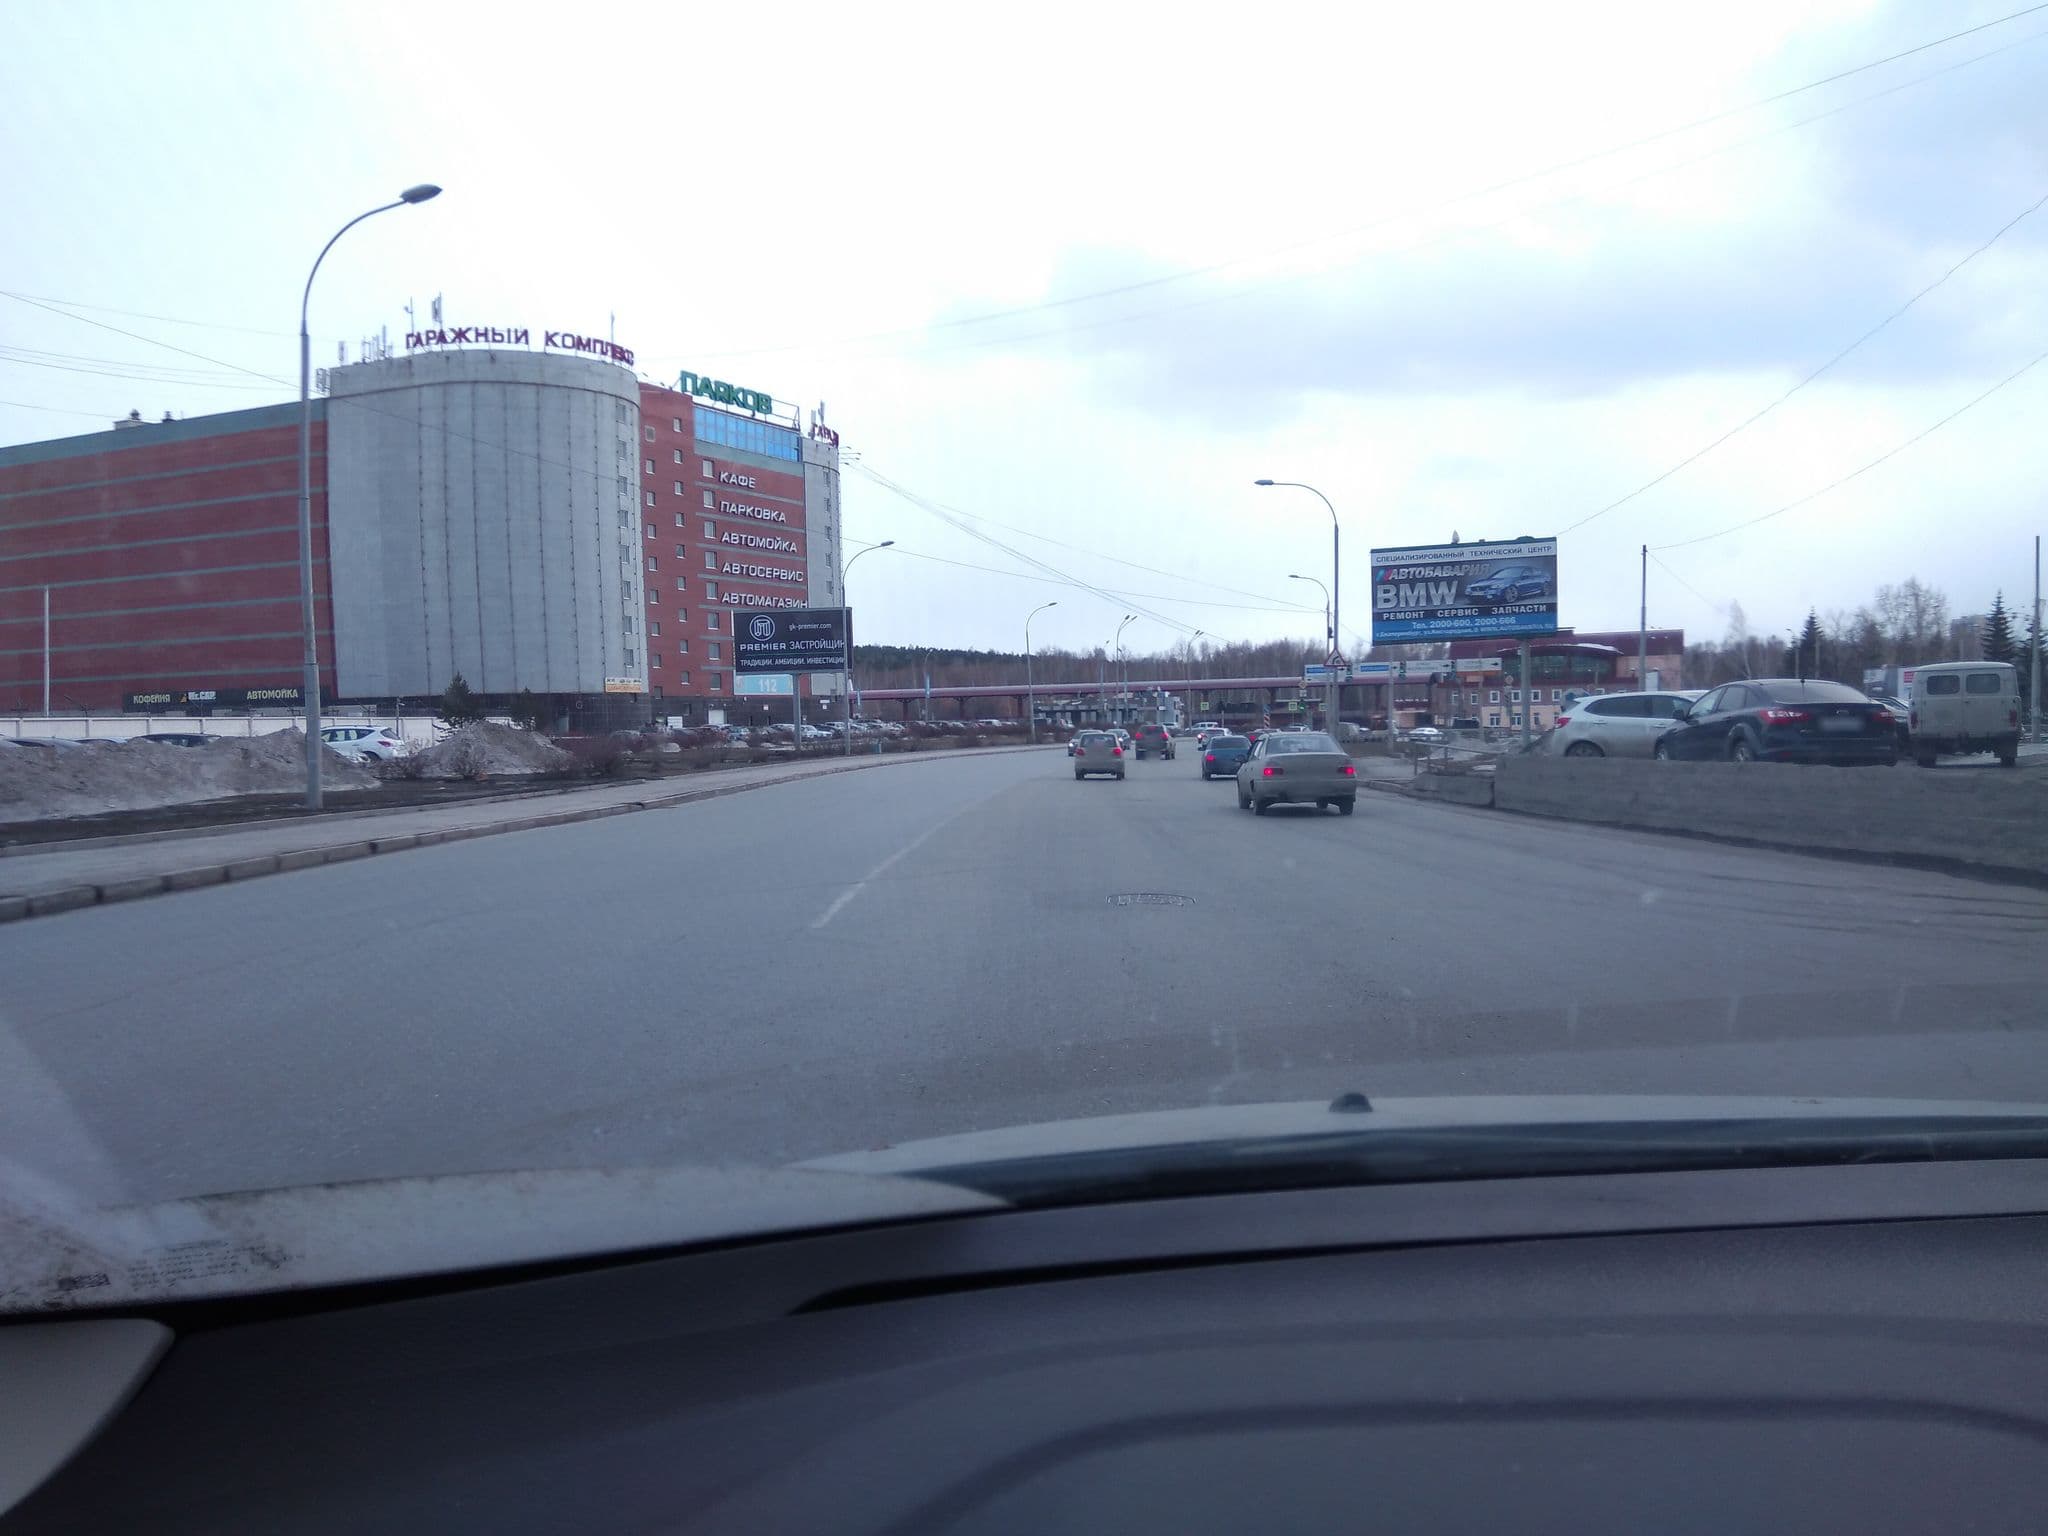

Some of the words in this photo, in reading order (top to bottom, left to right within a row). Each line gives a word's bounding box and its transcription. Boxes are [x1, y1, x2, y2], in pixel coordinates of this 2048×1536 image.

[680, 370, 773, 414] ПАРКОВ
[719, 471, 756, 489] КАФЕ
[719, 501, 787, 523] ПАРКОВКА
[721, 531, 798, 553] АВТОМОЙКА
[1376, 551, 1465, 563] СПЕЦИАЛИЗИРОВАННЫЙ
[1470, 546, 1522, 557] ТЕХНИЧЕСКИЙ
[1527, 545, 1552, 554] ЦЕНТР
[722, 562, 804, 582] АВТОСЕРВИС
[722, 592, 808, 609] АВТОМАГАЗИН
[1377, 580, 1459, 609] BMW
[1383, 611, 1425, 621] РЕМОНТ
[1437, 608, 1479, 618] СЕРВИС
[1491, 604, 1547, 615] ЗАПЧАСТИ
[789, 623, 832, 631] gk-premier.com
[740, 642, 787, 651] PREMIER
[246, 688, 299, 700] АВТОМОЙКА
